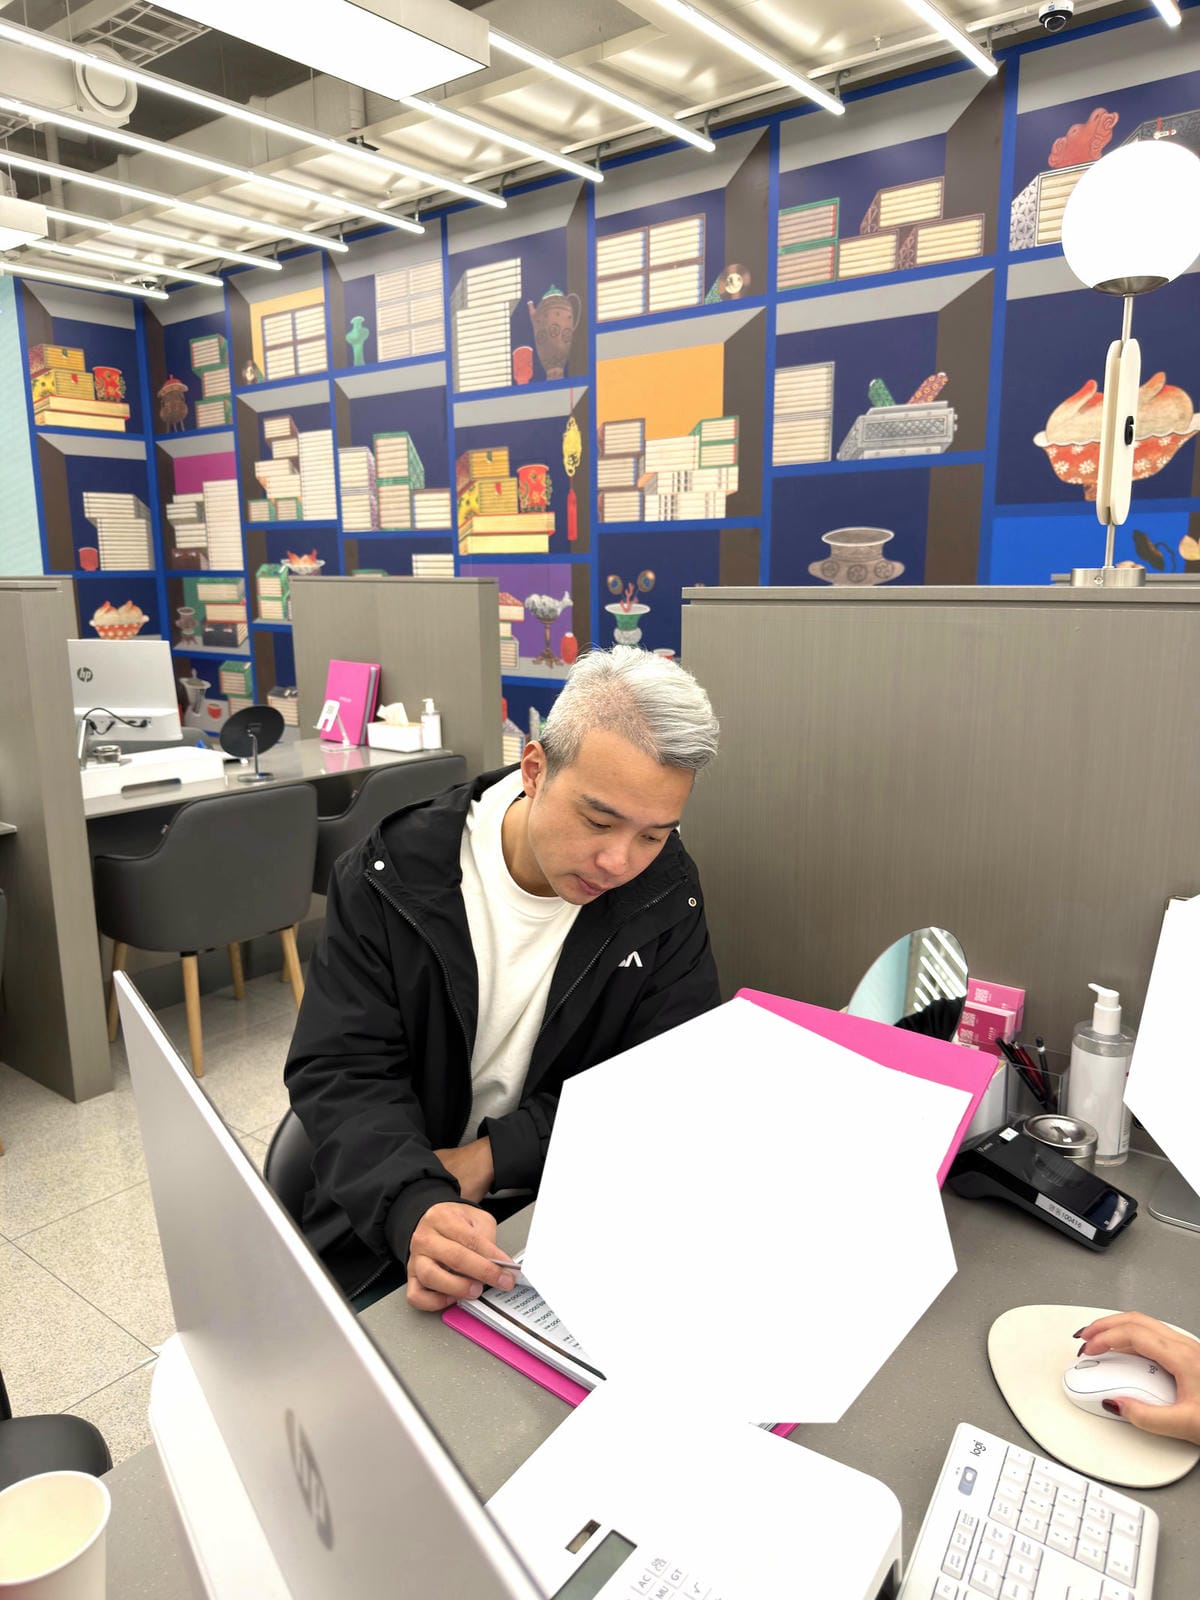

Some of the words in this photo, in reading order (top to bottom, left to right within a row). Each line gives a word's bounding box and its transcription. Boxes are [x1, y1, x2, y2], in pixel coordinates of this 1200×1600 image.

[77, 666, 93, 683] hp
[970, 1439, 986, 1457] logi
[638, 1574, 652, 1588] AC
[670, 1567, 683, 1581] GT
[655, 1585, 669, 1600] MU
